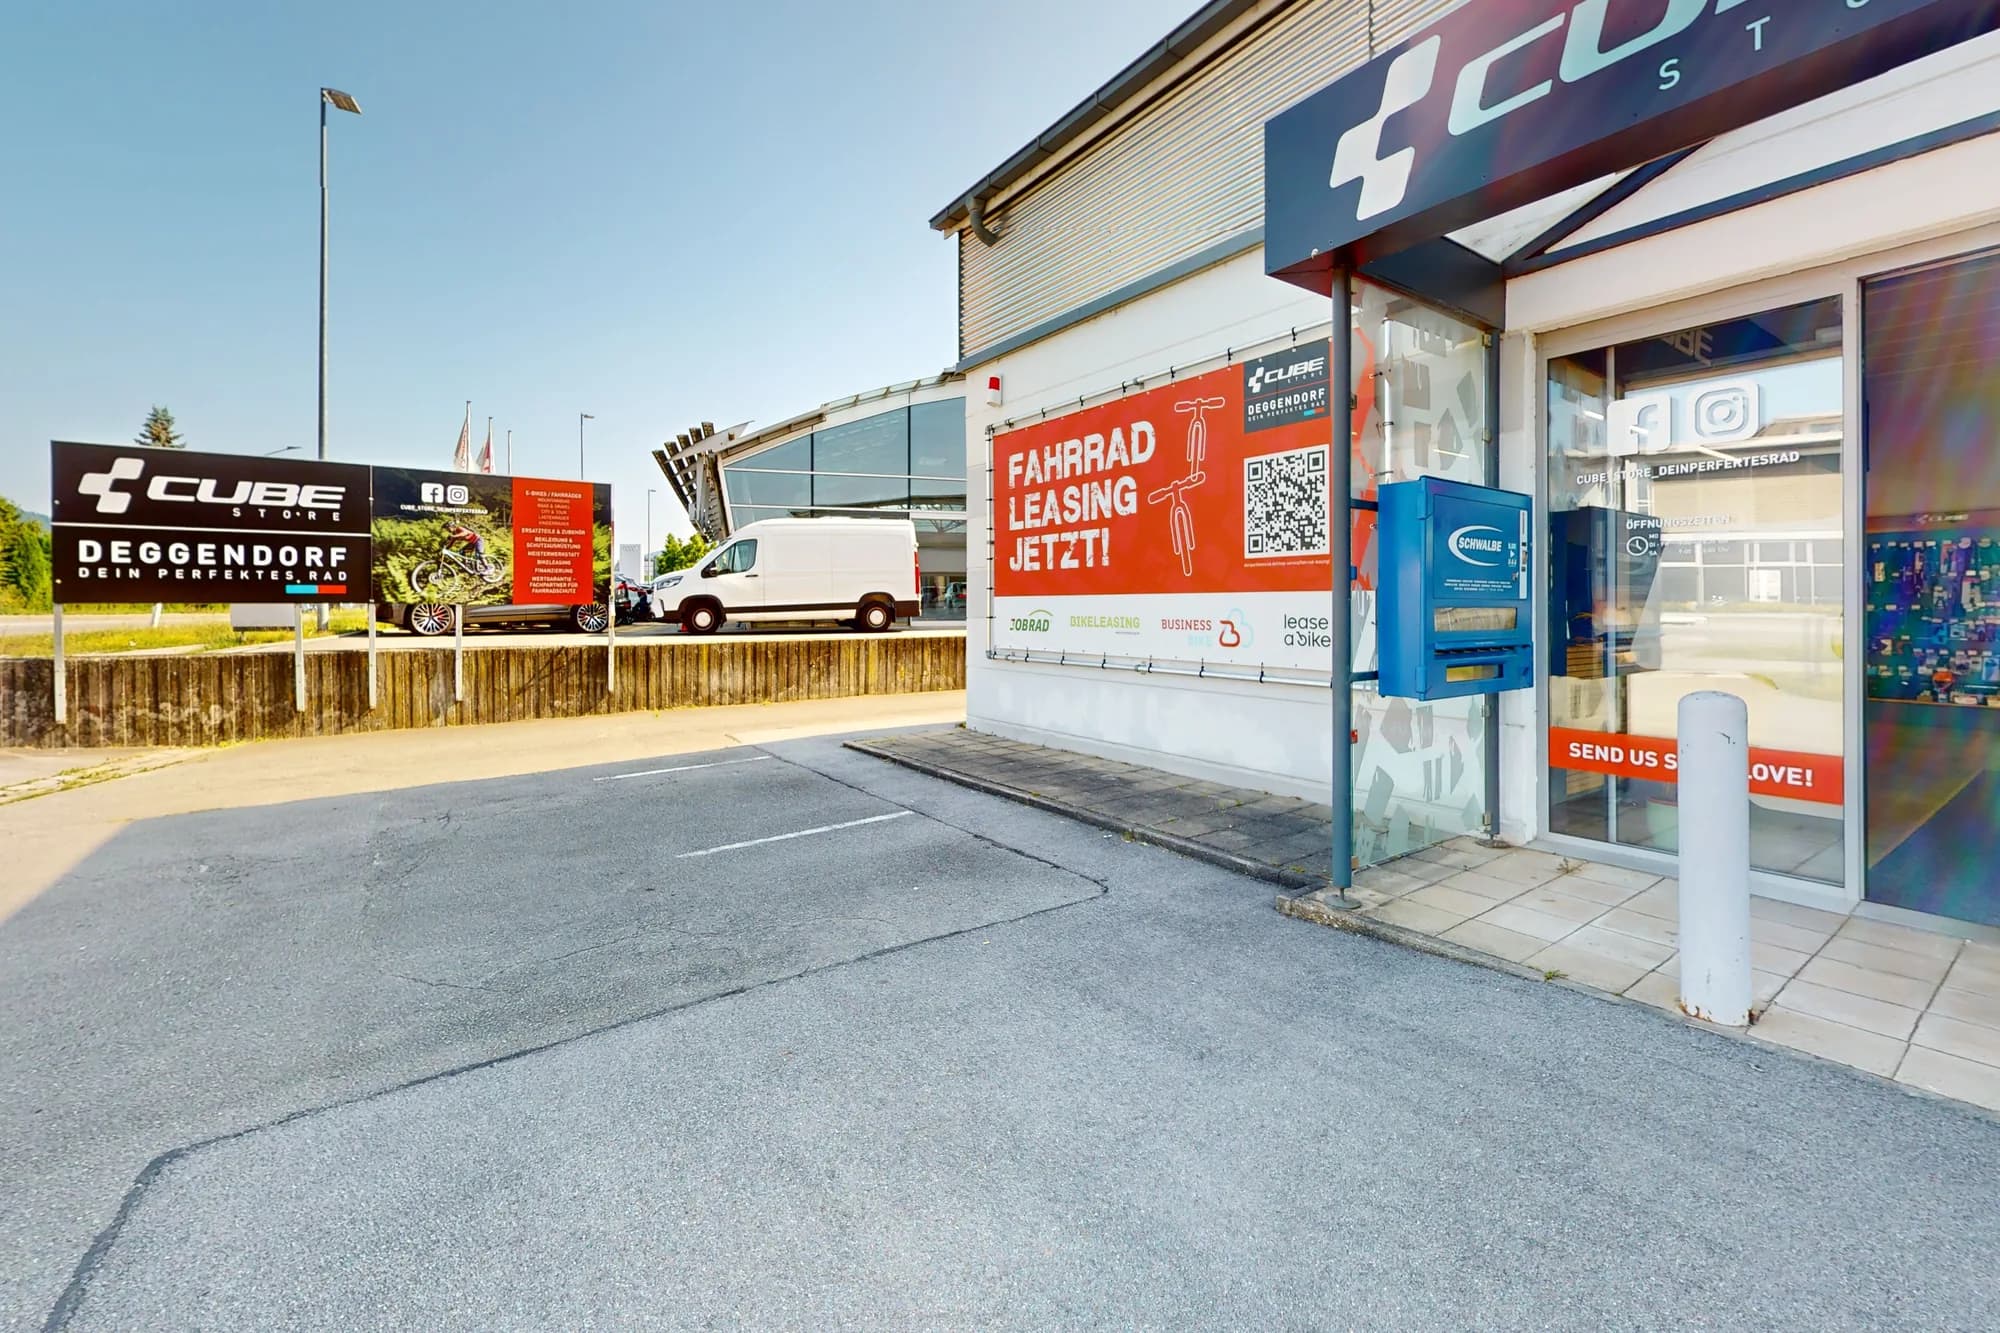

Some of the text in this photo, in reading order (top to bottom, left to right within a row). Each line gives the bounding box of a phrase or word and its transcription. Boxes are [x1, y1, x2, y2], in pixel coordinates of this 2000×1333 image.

[1447, 0, 1747, 136] CU
[1264, 357, 1325, 383] CUBE
[1248, 388, 1325, 415] DEGGENDORF
[1008, 420, 1157, 489] FAHRRAD
[147, 475, 346, 509] CUBE
[1008, 476, 1138, 531] LEASING
[232, 507, 341, 521] STORE
[78, 539, 347, 567] DEGGENDORF
[1009, 528, 1110, 572] JETZT!
[1458, 537, 1502, 552] SCHWALBE
[78, 567, 347, 581] DEIN PERFEKTES RAD
[1070, 616, 1140, 629] BIKELEASING
[1161, 619, 1212, 631] BUSINESS
[1284, 614, 1329, 630] lease
[1569, 742, 1624, 764] SEND
[1630, 751, 1658, 768] US
[1748, 763, 1813, 788] OVE!
